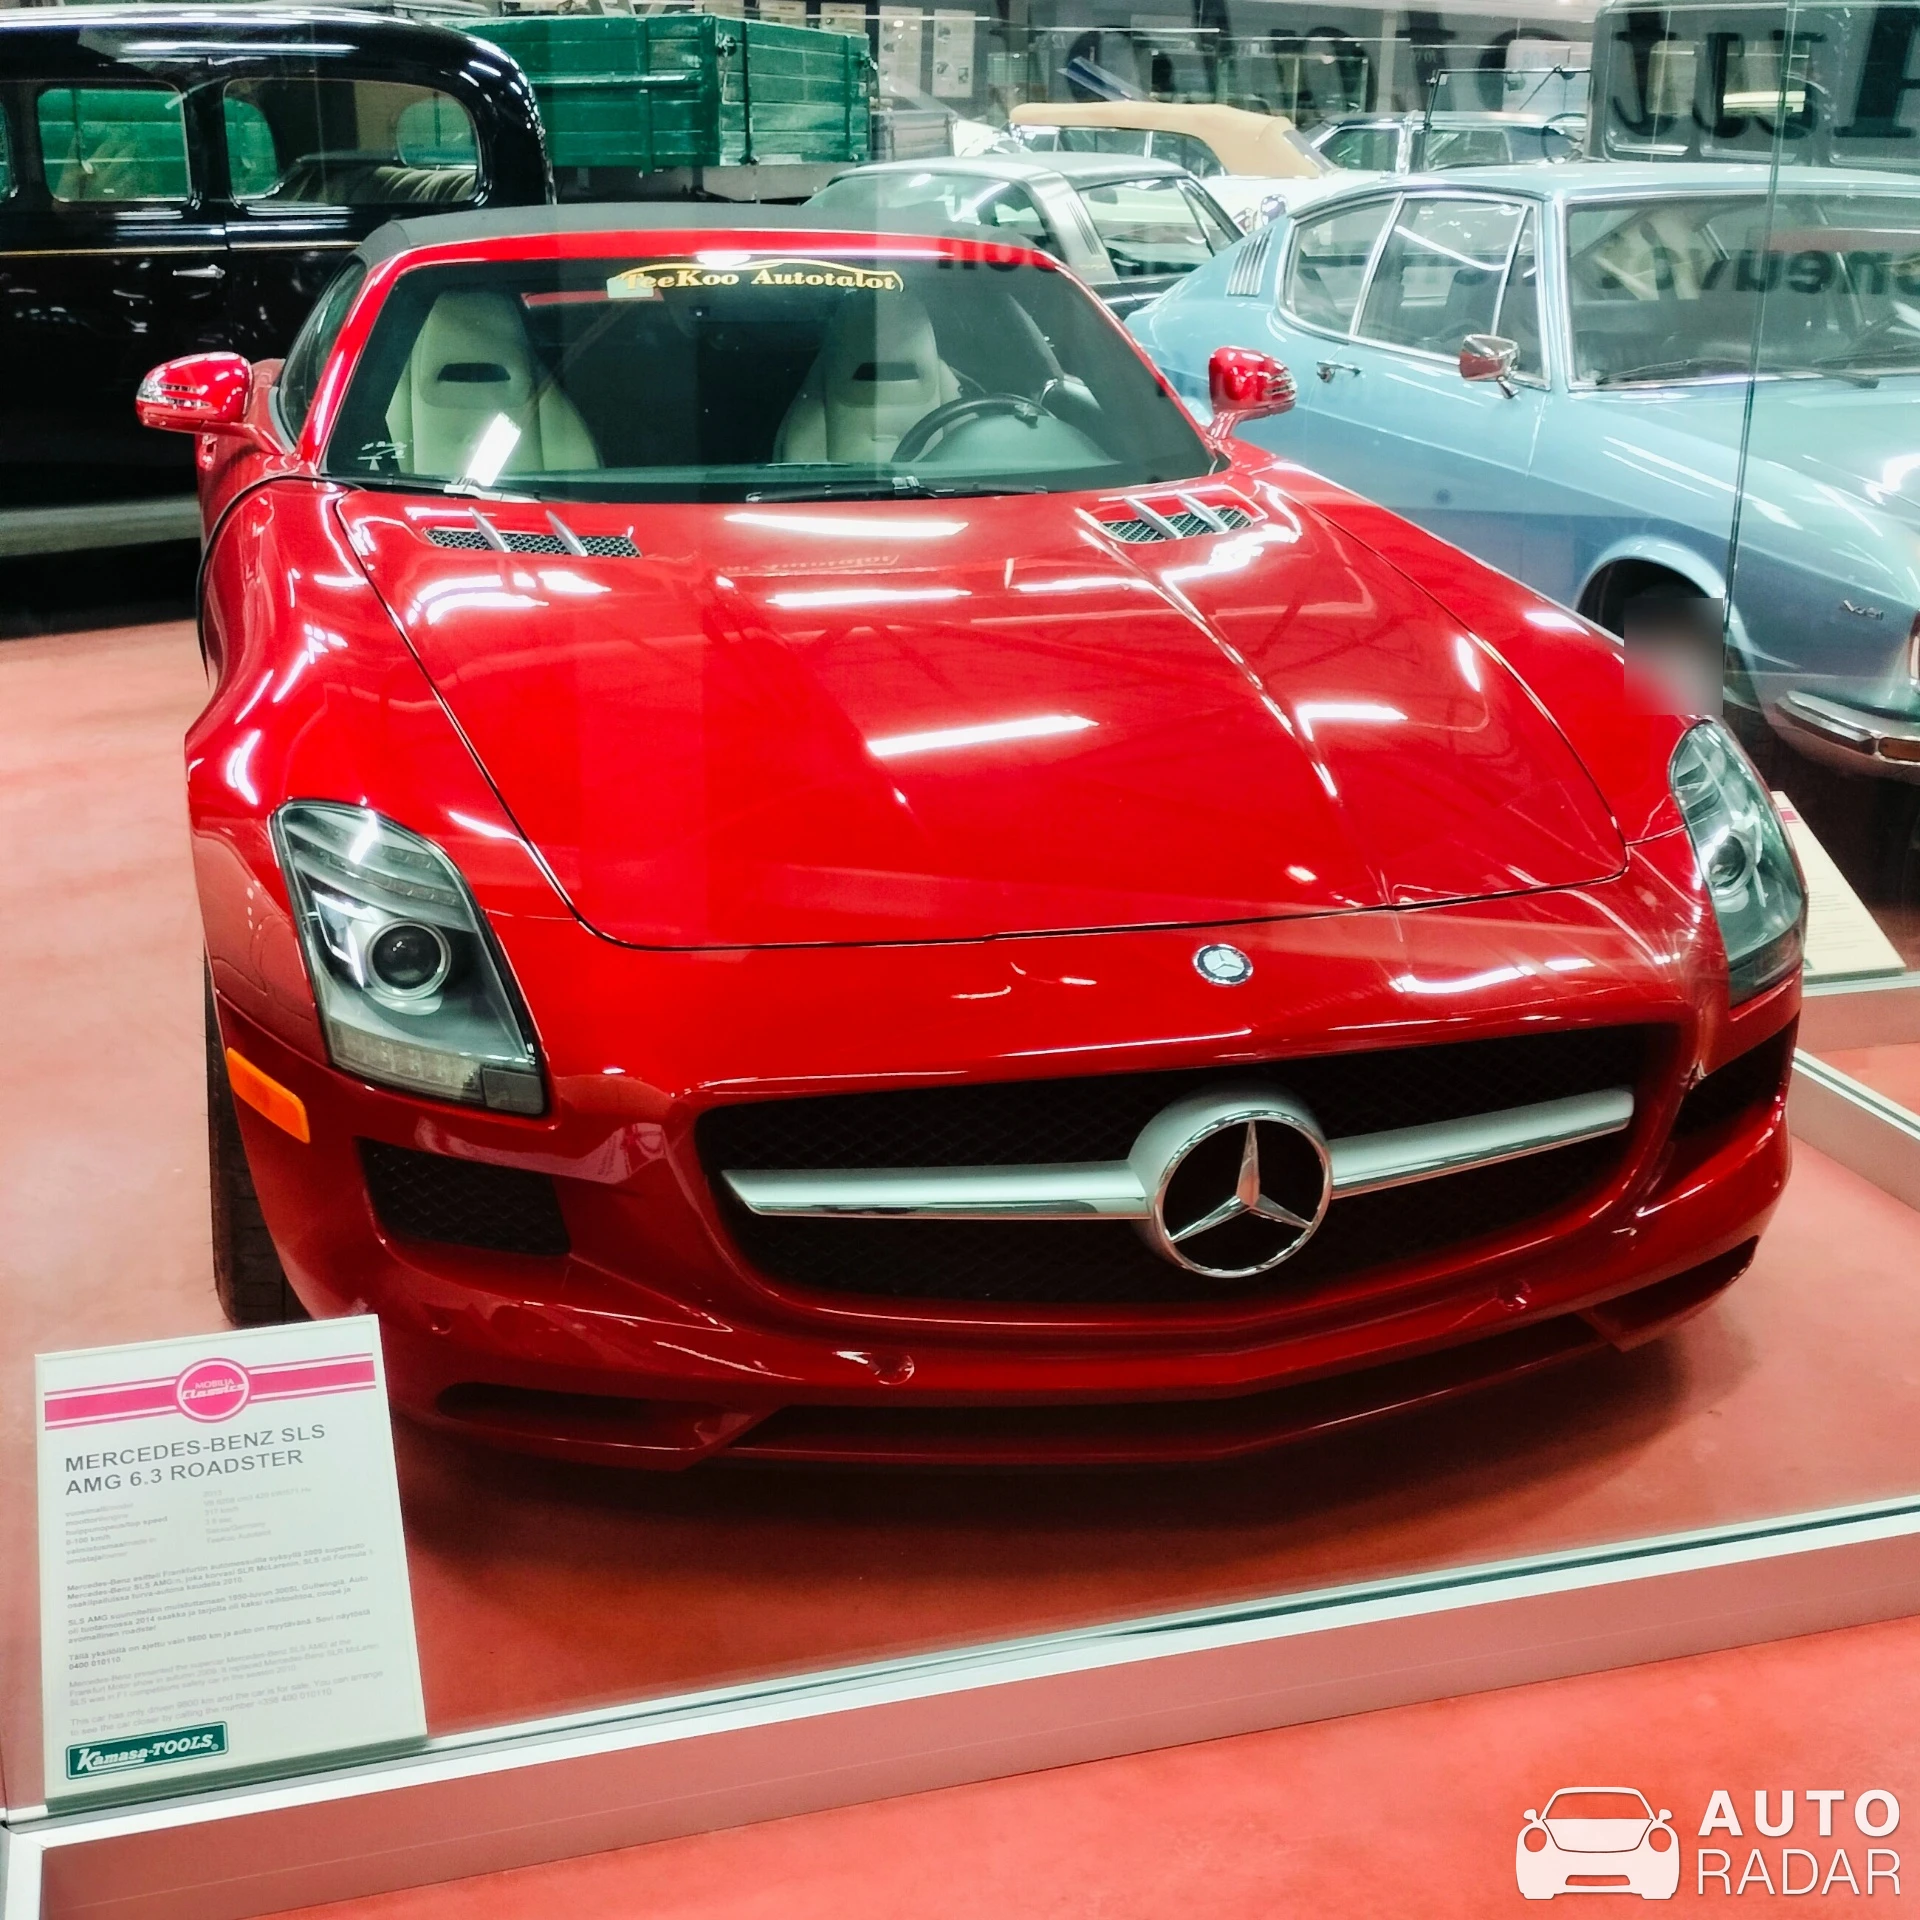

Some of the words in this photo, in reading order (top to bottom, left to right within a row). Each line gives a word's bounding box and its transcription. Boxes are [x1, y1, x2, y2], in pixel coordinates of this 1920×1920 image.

[626, 269, 739, 290] TeeKoo
[750, 268, 896, 291] Autotalot
[65, 1429, 274, 1472] MERCEDES-BENZ
[281, 1424, 326, 1443] SLS
[65, 1473, 122, 1496] AMG
[129, 1468, 163, 1486] 6.3
[170, 1449, 304, 1481] ROADSTER
